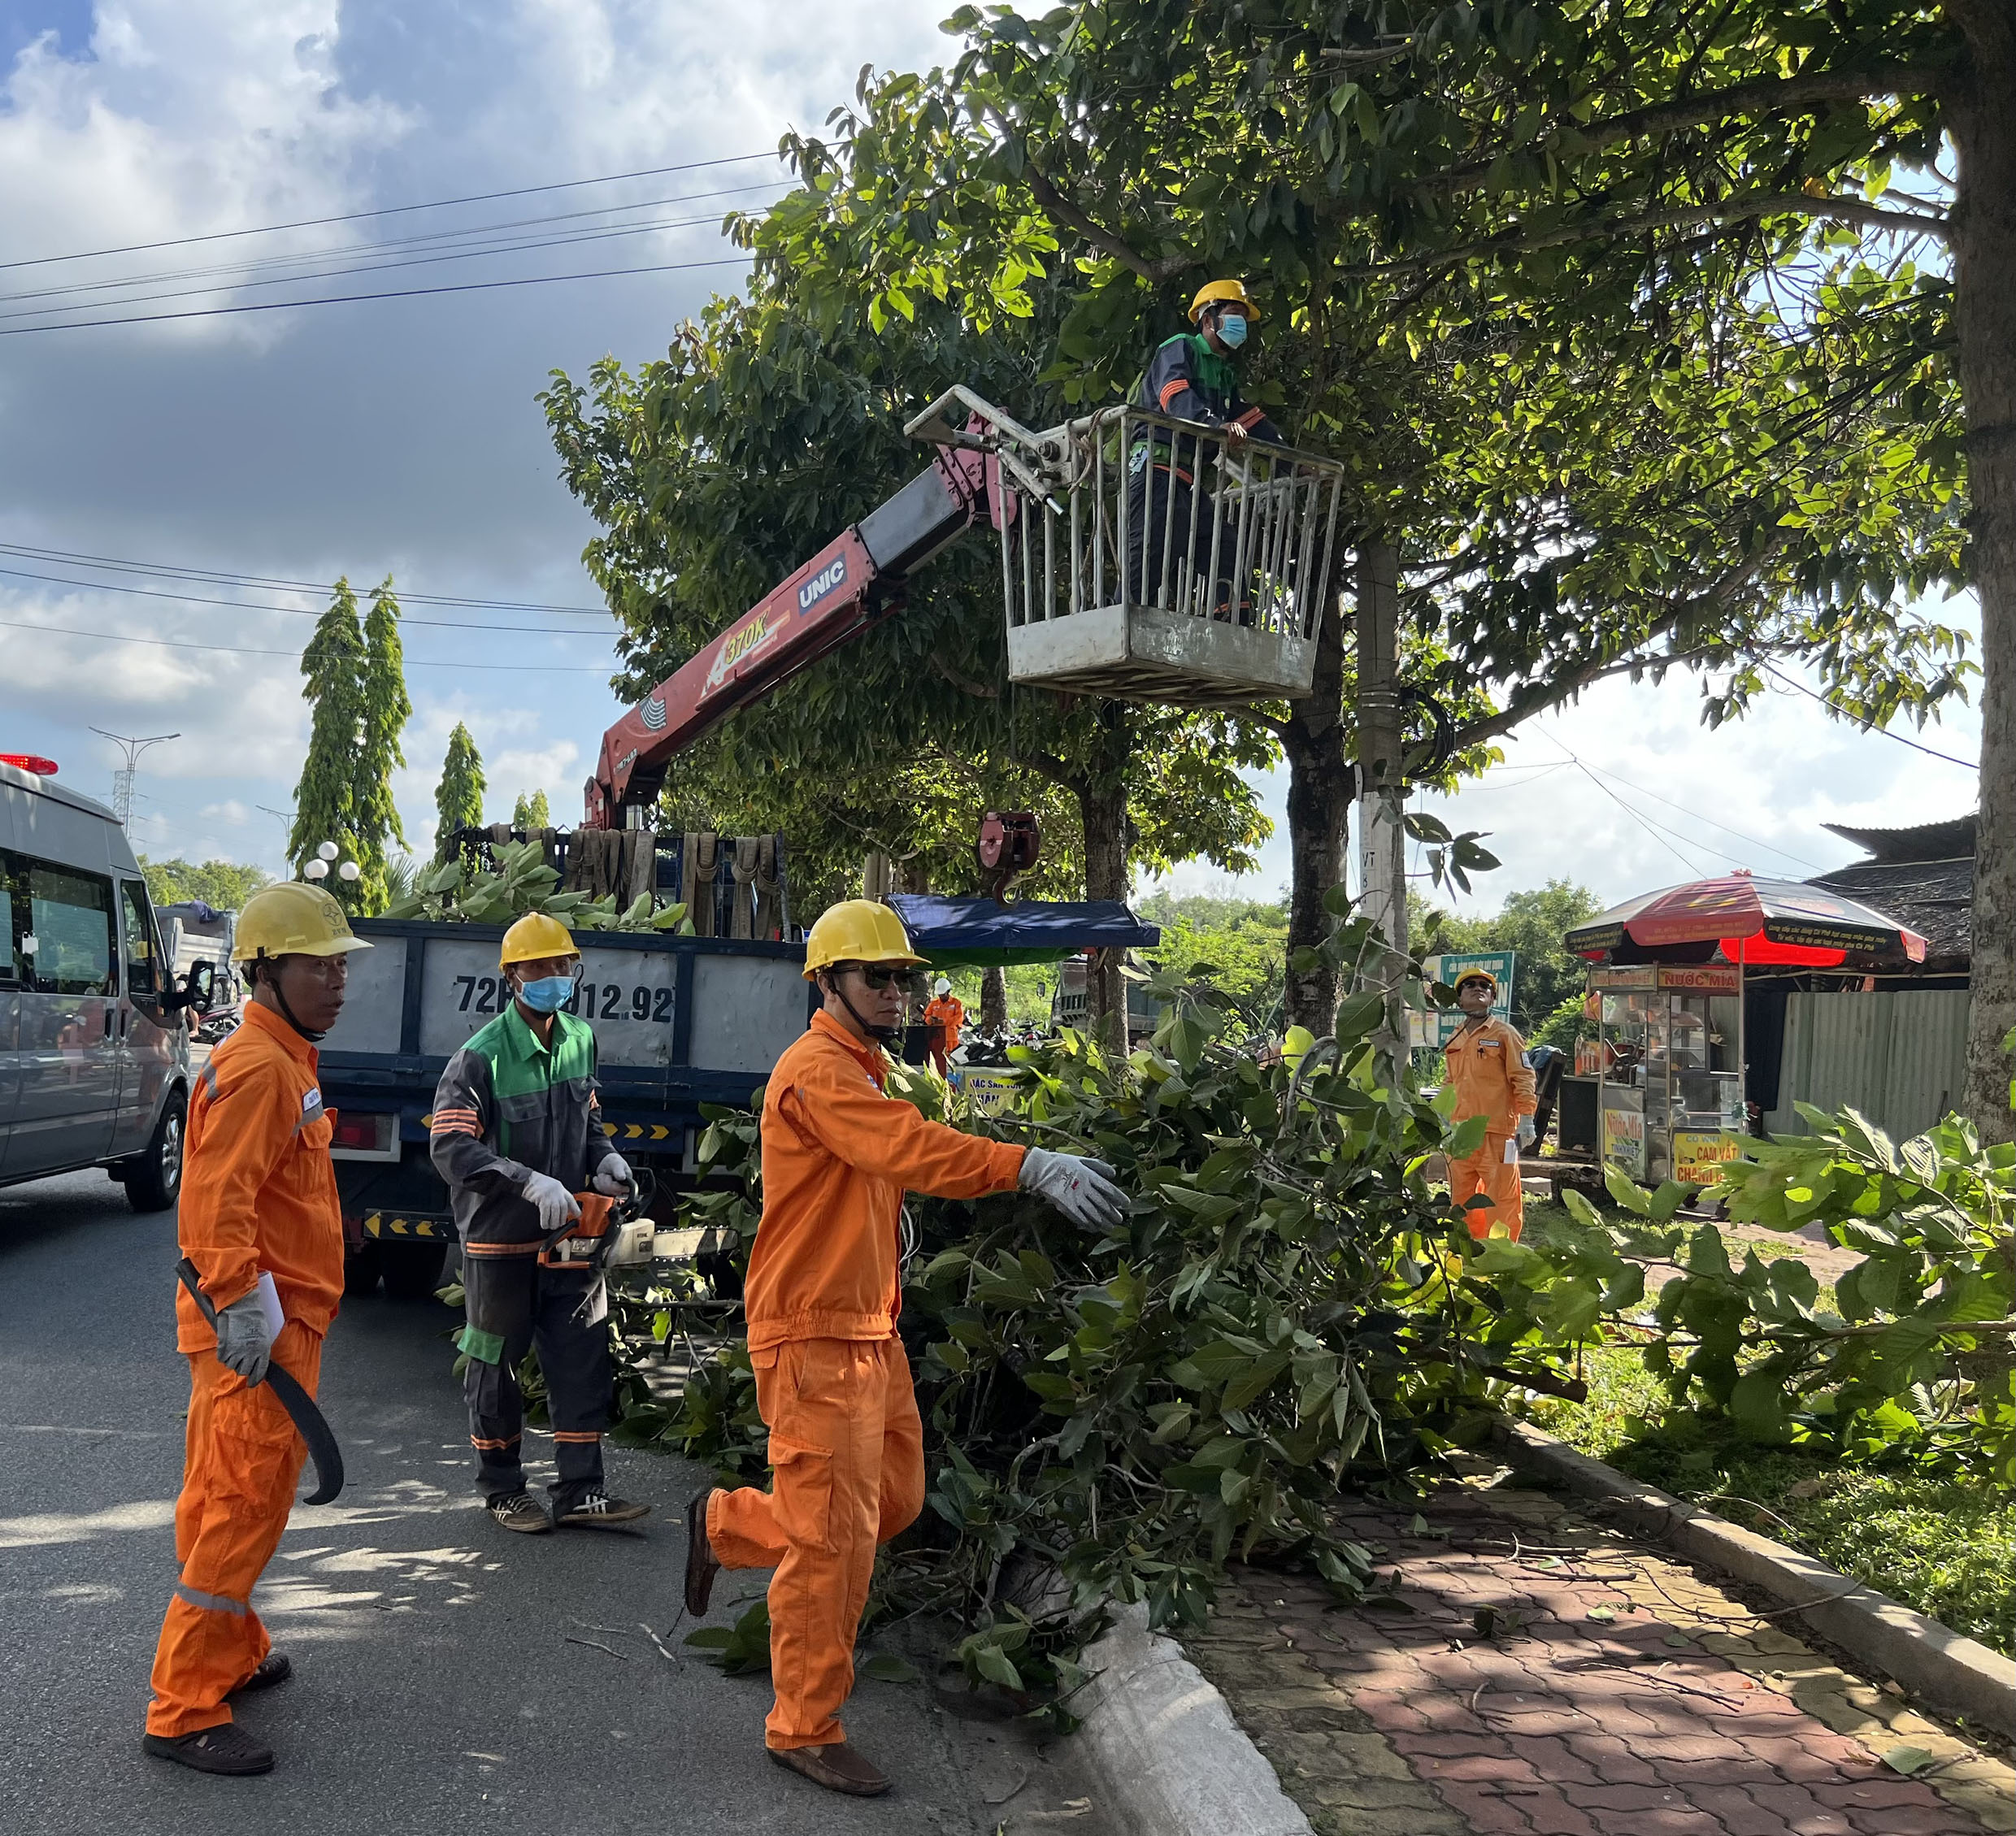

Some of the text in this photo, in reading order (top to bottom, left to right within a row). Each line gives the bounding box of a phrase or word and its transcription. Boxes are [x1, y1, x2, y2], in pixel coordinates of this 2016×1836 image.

[800, 561, 844, 608] UNIC
[1362, 852, 1375, 867] VT
[1665, 971, 1735, 986] NƯỚC MÍA
[1701, 1135, 1719, 1144] WIFI
[1697, 1147, 1717, 1161] CAM
